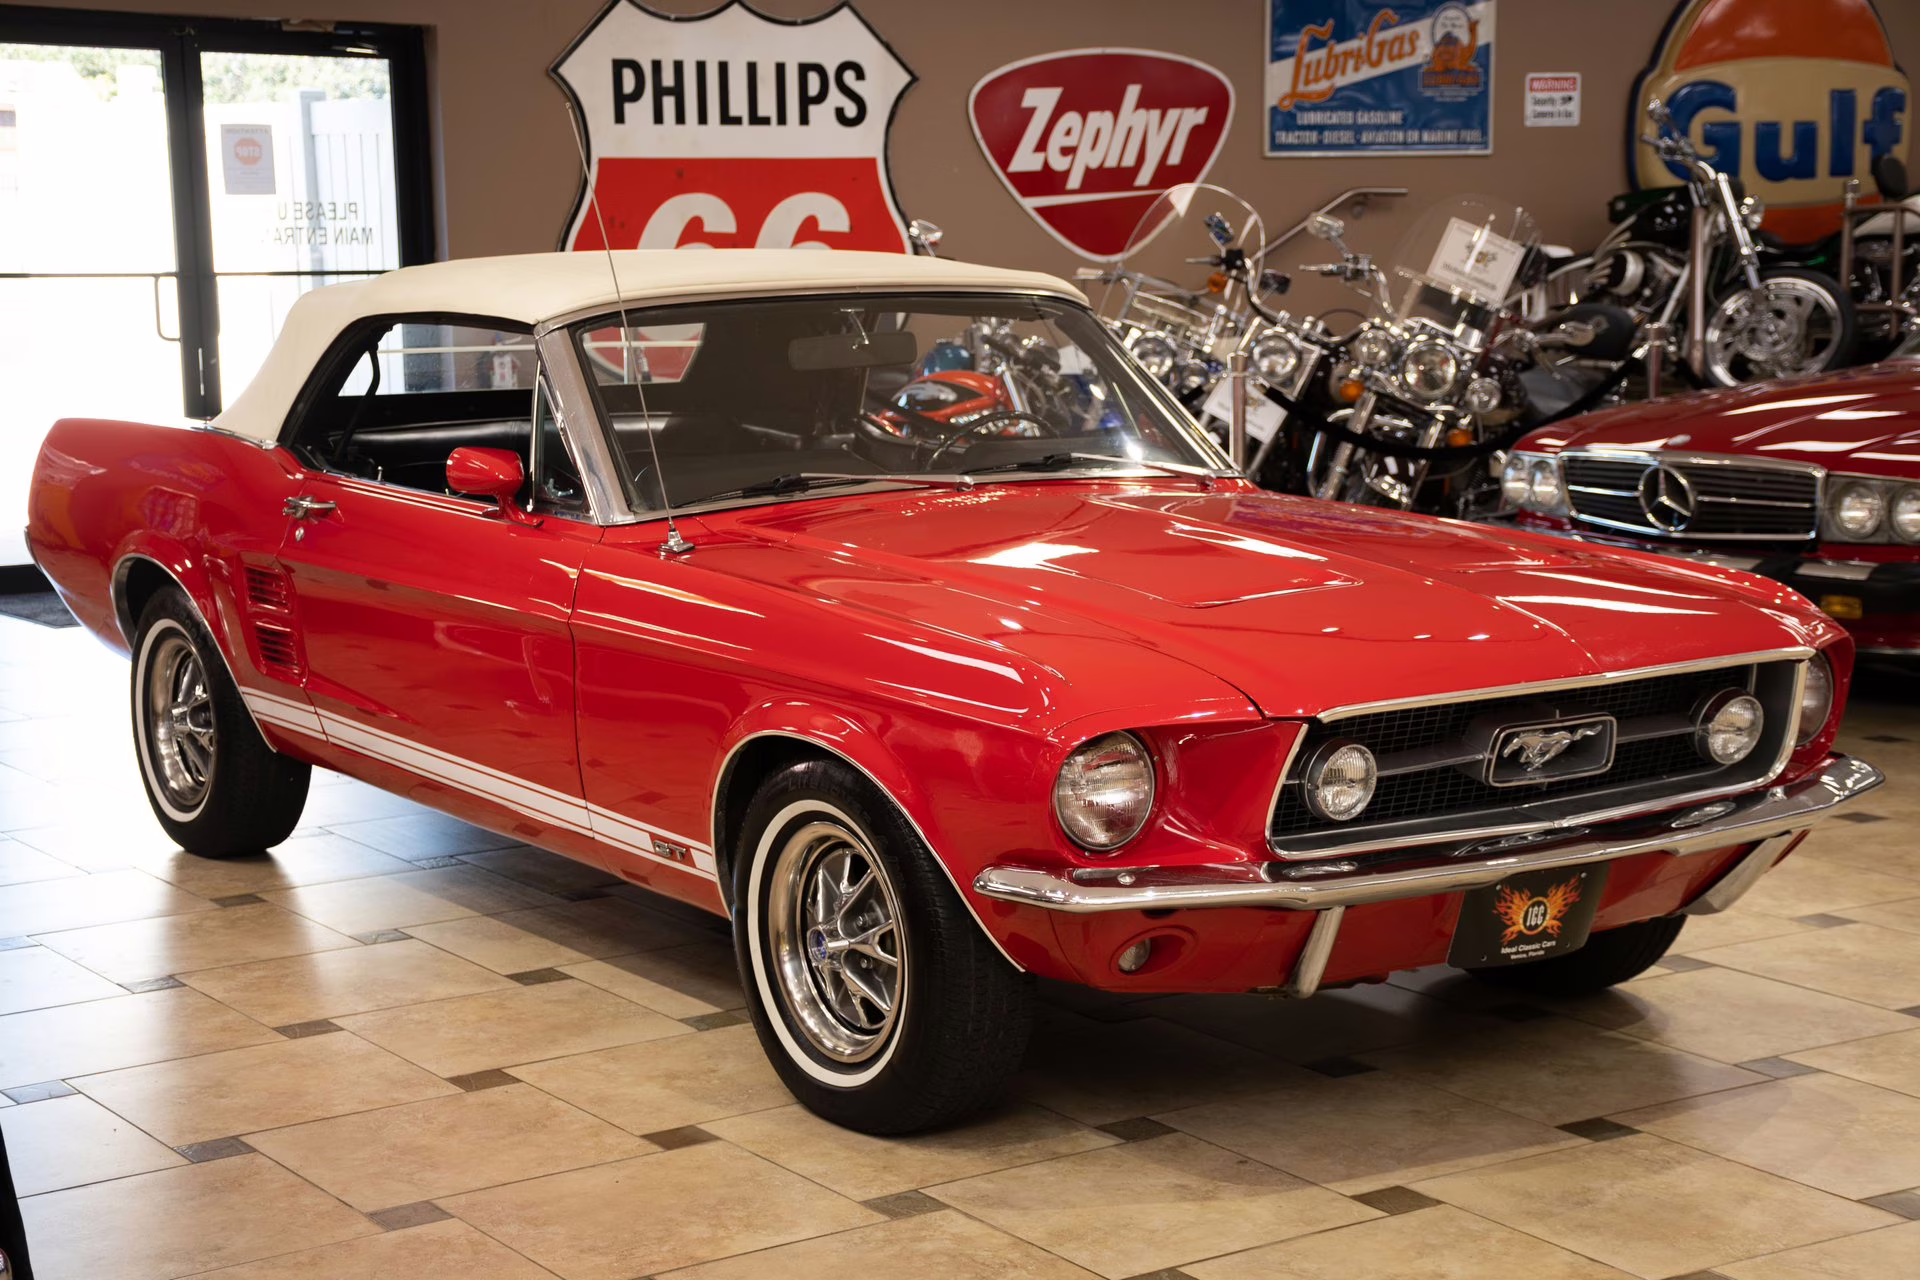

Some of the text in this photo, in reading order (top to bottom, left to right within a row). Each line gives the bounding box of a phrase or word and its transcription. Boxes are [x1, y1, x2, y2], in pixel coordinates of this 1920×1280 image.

[611, 58, 868, 128] PHILLIPS
[1296, 110, 1404, 125] LUBRICATED GASOLINE
[1006, 83, 1210, 190] Zephyr
[1275, 130, 1319, 145] TRACTOR
[1322, 130, 1356, 145] DIESEL
[1360, 129, 1404, 144] AVIATION
[1423, 129, 1458, 143] MARINE
[1658, 79, 1907, 184] Gulf
[653, 839, 687, 860] GT
[1501, 940, 1556, 954] Ideal Classic Cars
